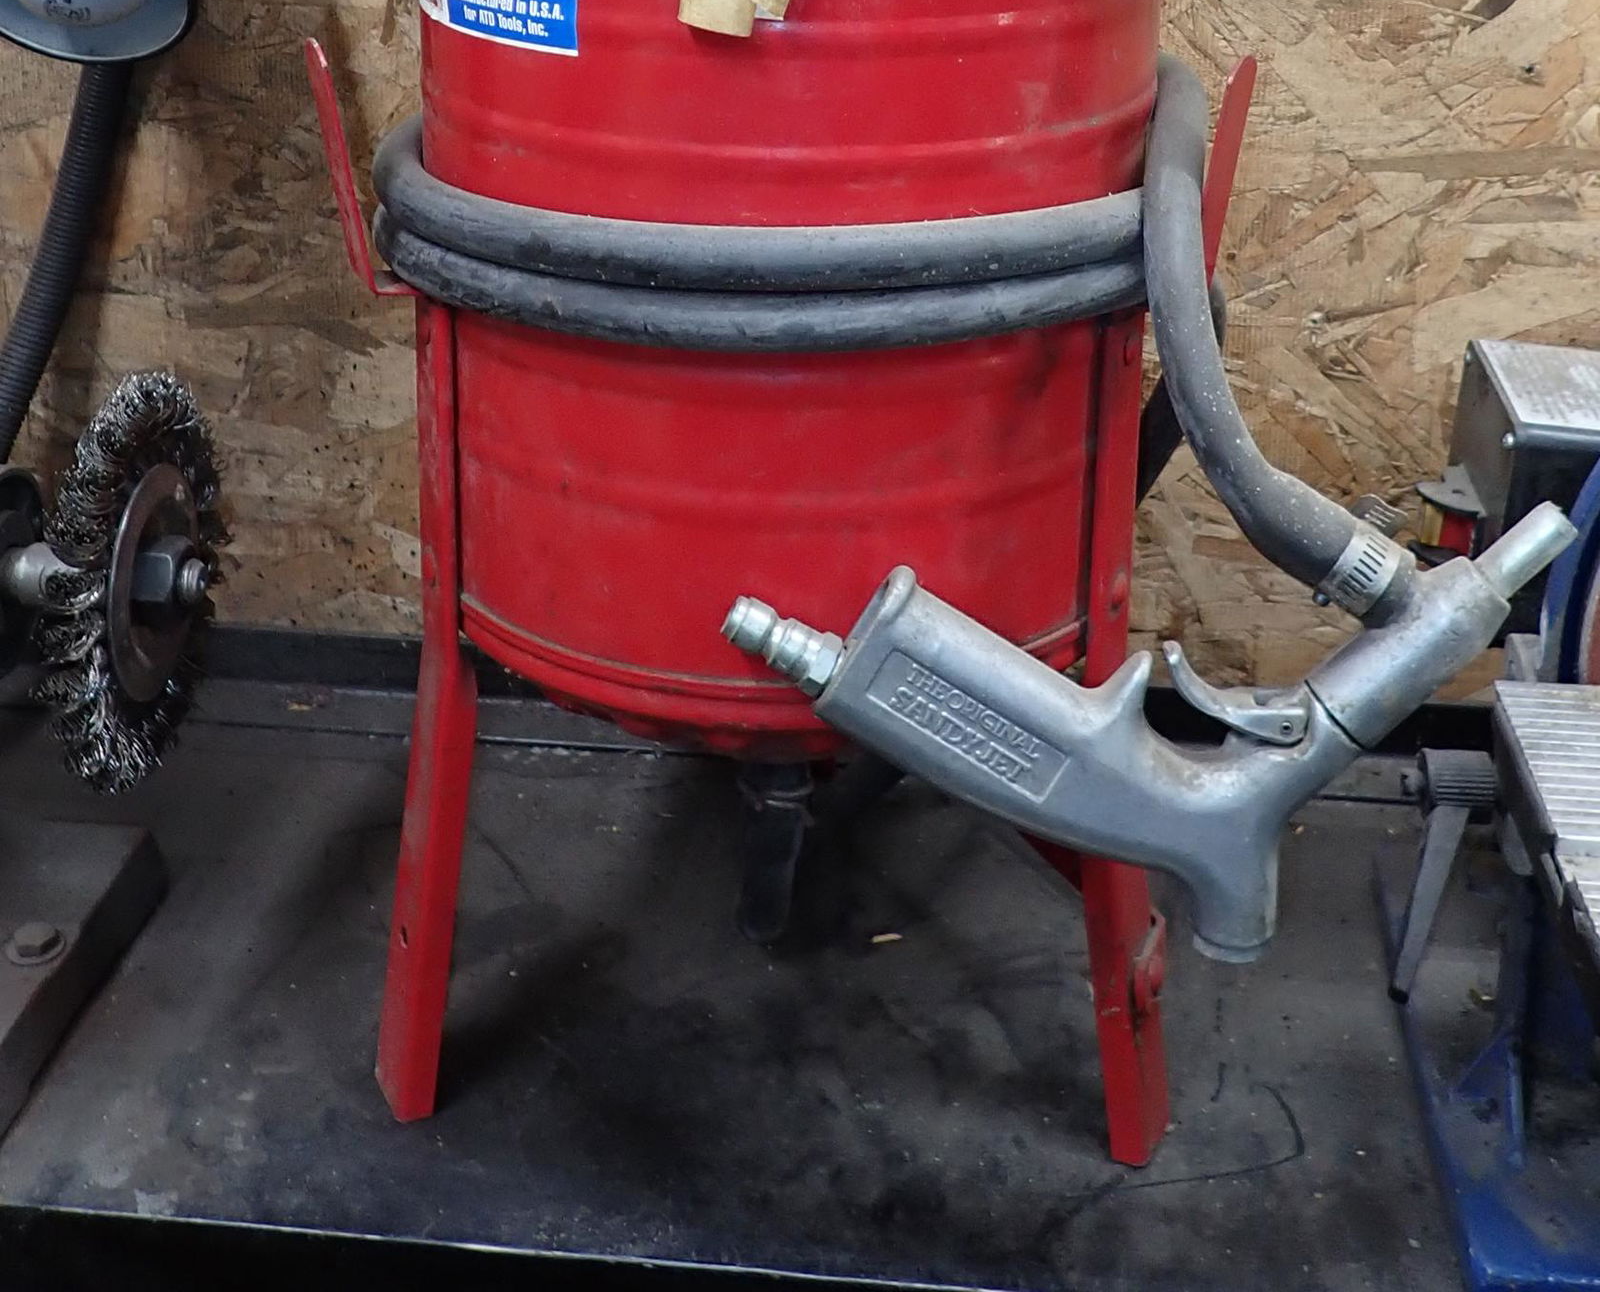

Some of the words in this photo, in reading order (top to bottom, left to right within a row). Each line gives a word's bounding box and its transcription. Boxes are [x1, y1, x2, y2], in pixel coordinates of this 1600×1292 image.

[463, 5, 477, 21] for
[478, 7, 496, 28] ATD
[496, 11, 527, 36] Tools,
[527, 17, 549, 38] Inc.
[528, 0, 565, 21] U.S.A.
